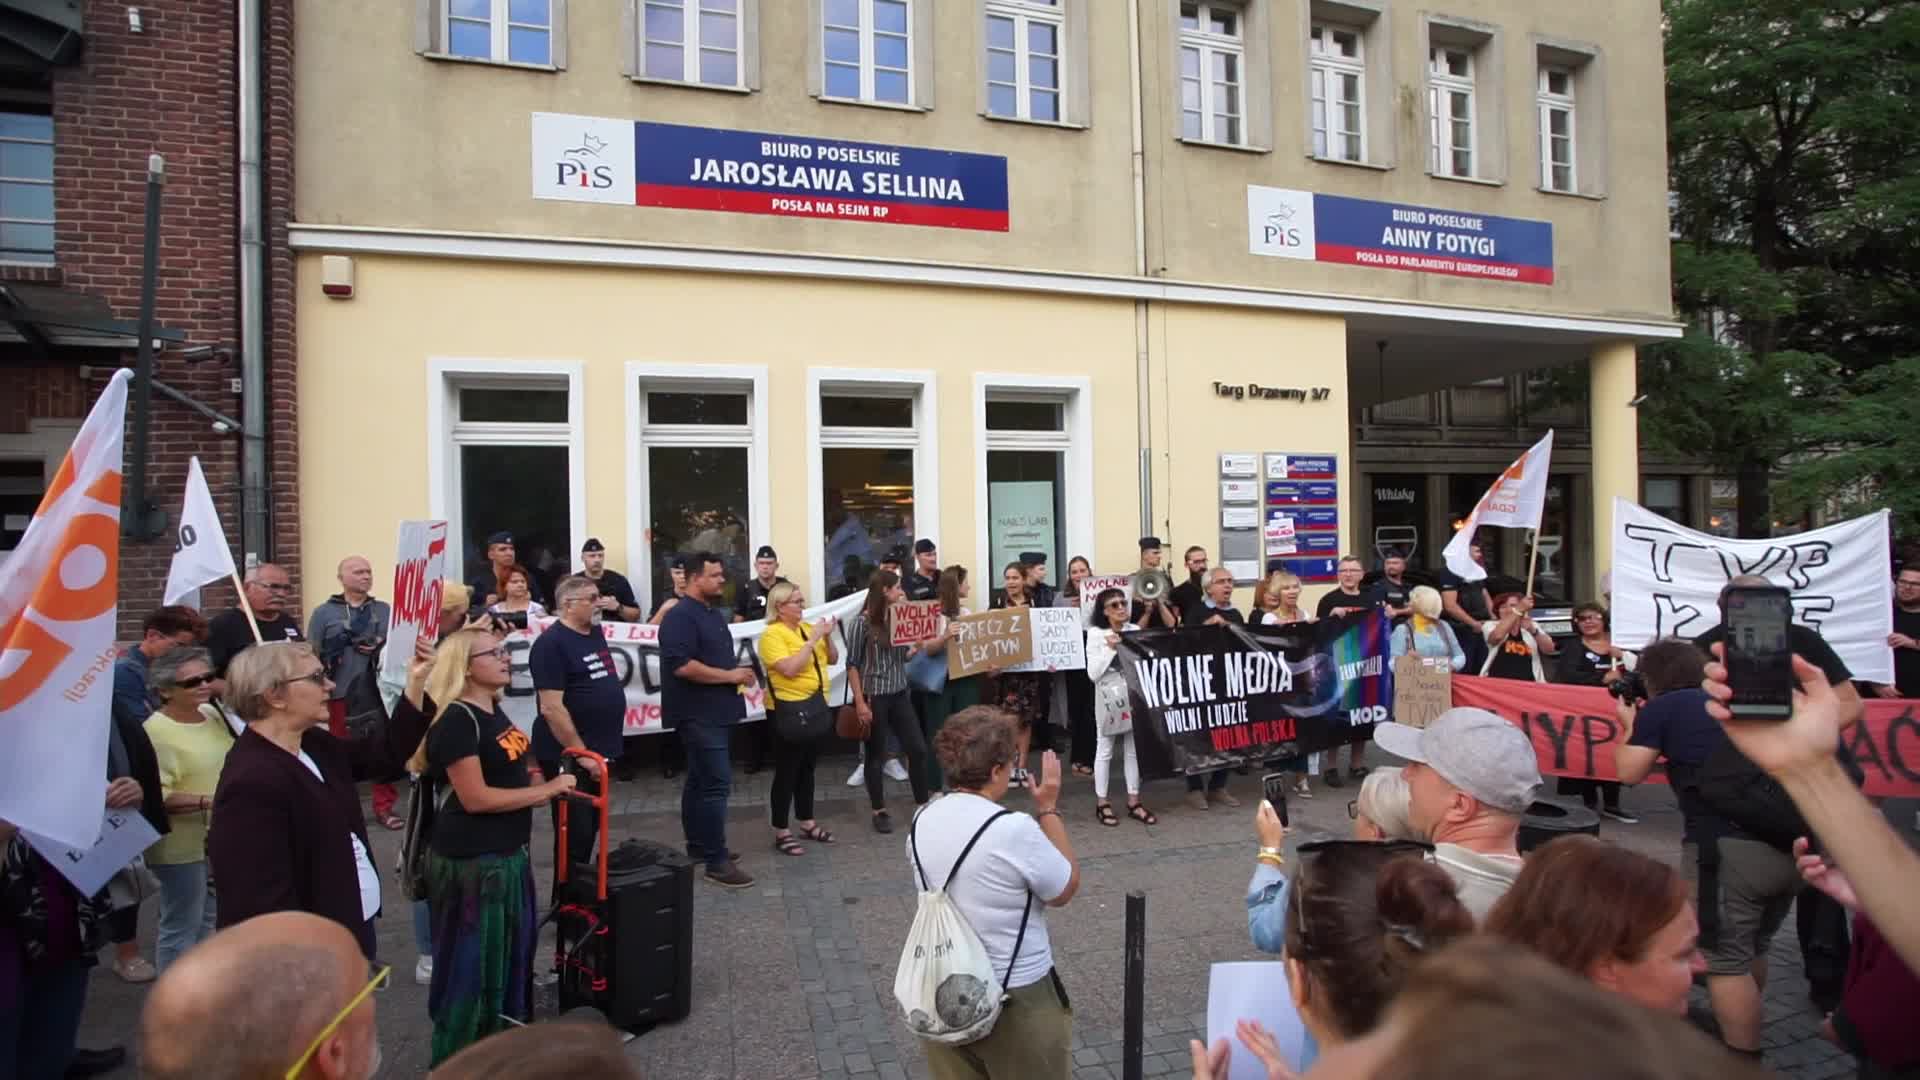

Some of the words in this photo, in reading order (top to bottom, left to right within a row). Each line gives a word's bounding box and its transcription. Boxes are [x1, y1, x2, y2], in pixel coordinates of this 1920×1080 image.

[761, 141, 811, 161] BIURO
[817, 146, 901, 167] POSELSKIE
[556, 162, 612, 188] PiS
[690, 158, 855, 194] JAROSŁAWA
[862, 173, 965, 201] SELLINA
[771, 197, 812, 214] POSŁA
[816, 201, 834, 214] NA
[836, 203, 869, 217] SEJM
[872, 205, 889, 218] RP
[1392, 208, 1426, 225] BIURO
[1428, 212, 1483, 230] POSELSKIE
[1263, 225, 1301, 247] PiS
[1382, 226, 1432, 248] ANNY
[1436, 232, 1496, 257] FOTYGI
[1213, 382, 1244, 399] Targ
[1248, 384, 1307, 403] Drzewny
[1311, 388, 1331, 400] 3/7
[1375, 487, 1415, 503] Whisky
[1625, 523, 1833, 590] TVP
[1084, 577, 1129, 590] WOLNE
[895, 602, 944, 620] WOLNE
[1040, 609, 1073, 623] MEDIA
[958, 618, 1005, 645] PRECZ
[1009, 615, 1024, 633] Z
[959, 643, 990, 671] LEX
[992, 637, 1023, 656] TVN
[1040, 640, 1077, 656] LUDZIE
[1135, 653, 1217, 709] WOLNE
[1164, 706, 1202, 734] WOLNI
[1207, 700, 1249, 729] LUDZIE
[1349, 704, 1388, 727] KOD
[1211, 725, 1250, 752] WOLNA
[1252, 718, 1297, 745] POLSKA
